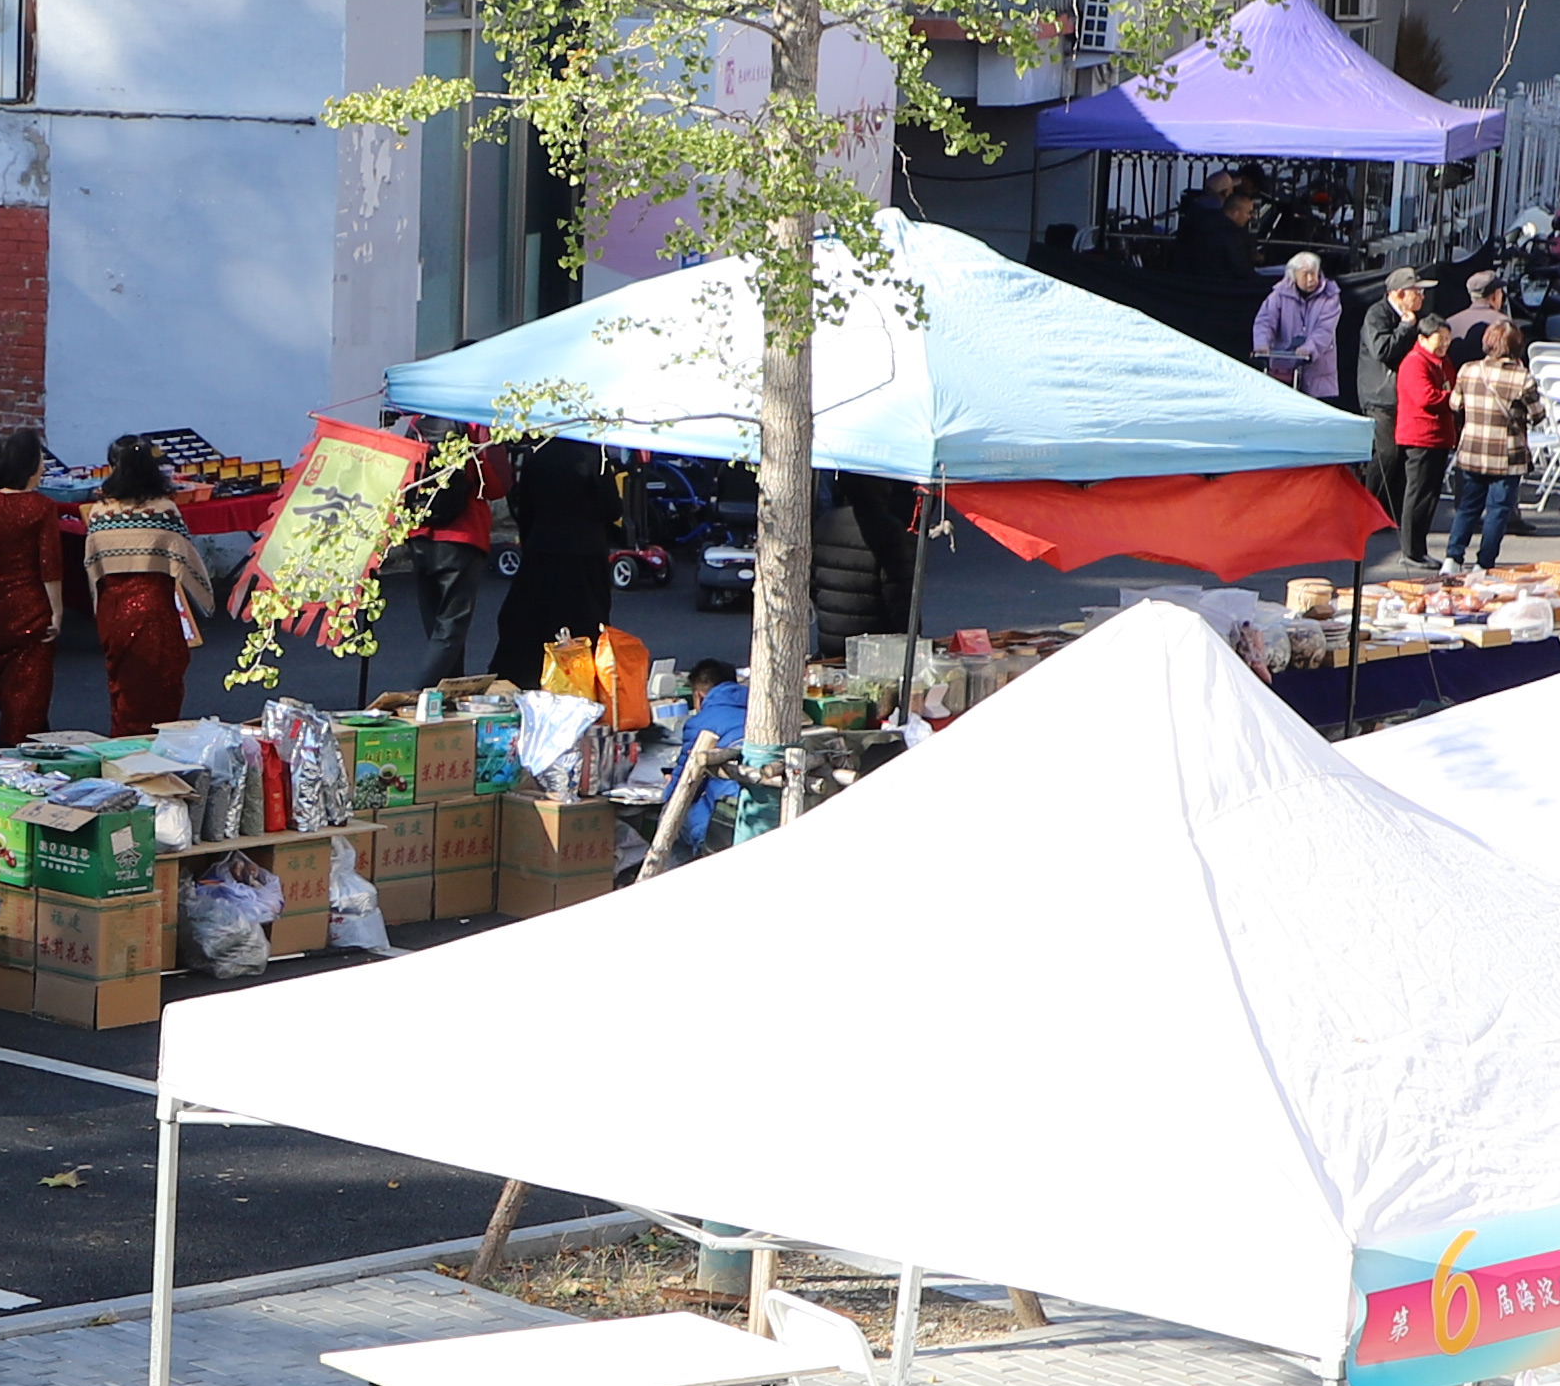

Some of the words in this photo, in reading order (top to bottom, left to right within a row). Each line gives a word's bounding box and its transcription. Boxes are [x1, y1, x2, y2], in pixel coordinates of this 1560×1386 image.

[421, 758, 473, 782] 茉莉花茶
[381, 842, 432, 868] 茉莉花茶
[442, 834, 494, 858] 茉莉花茶
[39, 936, 93, 964] 茉莉花茶
